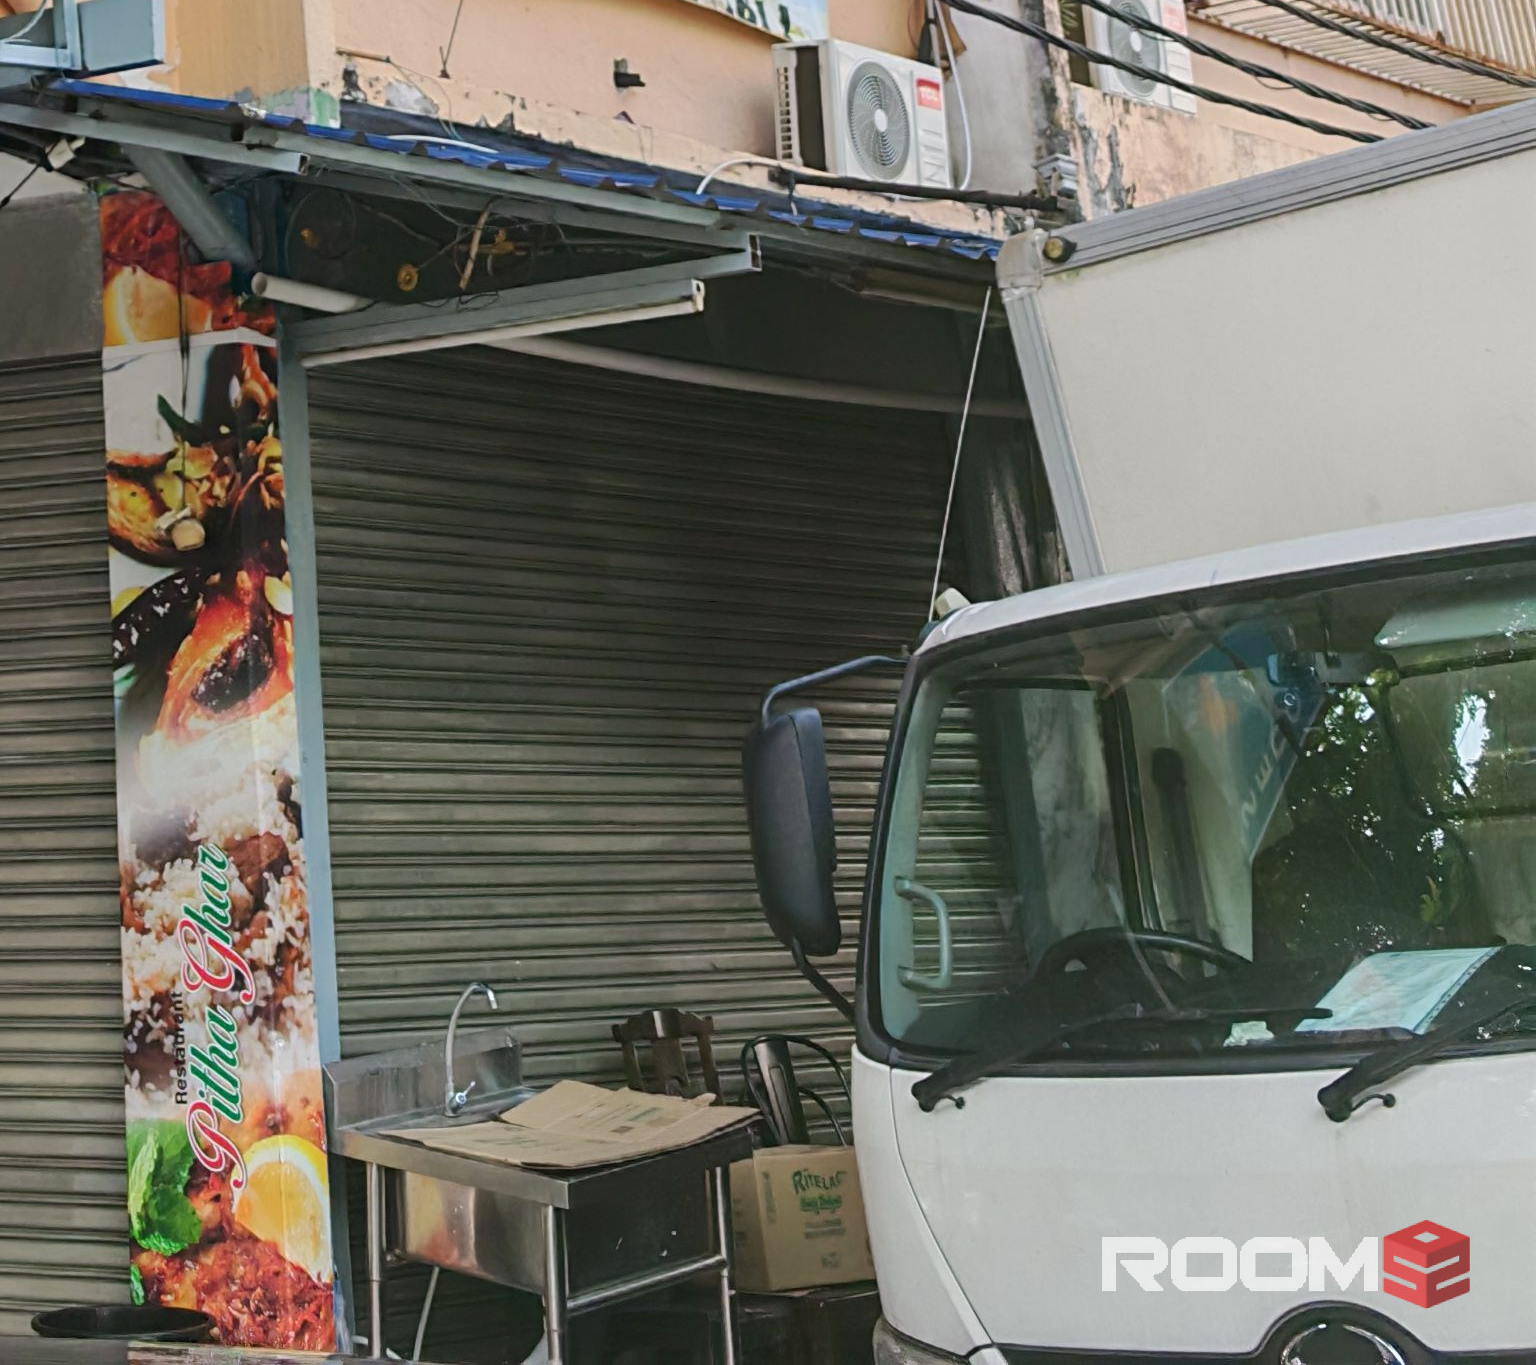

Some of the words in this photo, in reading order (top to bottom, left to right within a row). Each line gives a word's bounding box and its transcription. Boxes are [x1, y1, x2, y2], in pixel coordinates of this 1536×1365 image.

[178, 843, 256, 1005] Ghar
[174, 991, 188, 1105] Restaurant
[186, 1006, 247, 1189] Pitha
